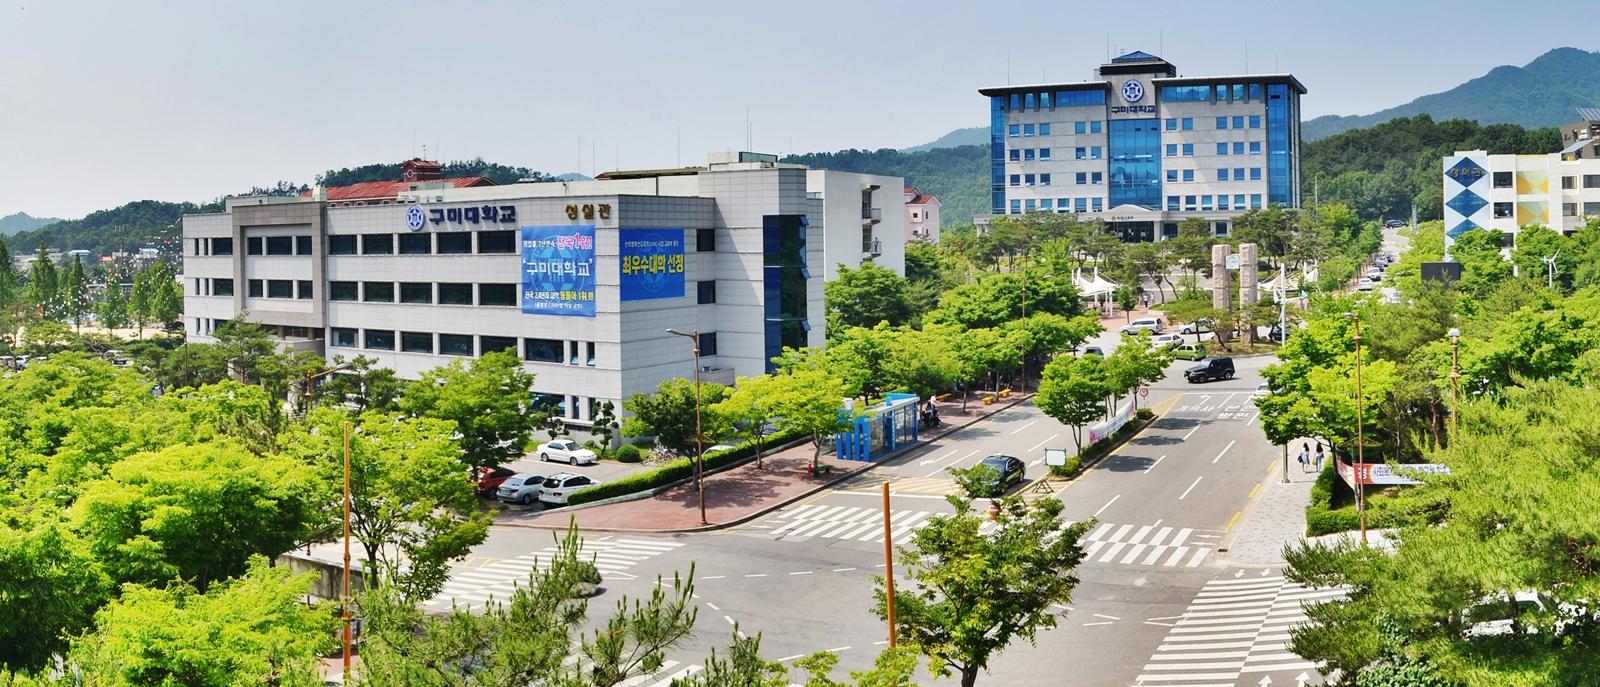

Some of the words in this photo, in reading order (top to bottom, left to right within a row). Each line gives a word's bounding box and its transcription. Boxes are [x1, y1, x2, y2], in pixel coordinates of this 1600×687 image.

[1111, 105, 1156, 113] 구미대학교
[429, 205, 516, 225] 구미대학교
[566, 204, 611, 220] 성실관
[623, 254, 667, 275] 최우수대학
[668, 253, 684, 273] 선정
